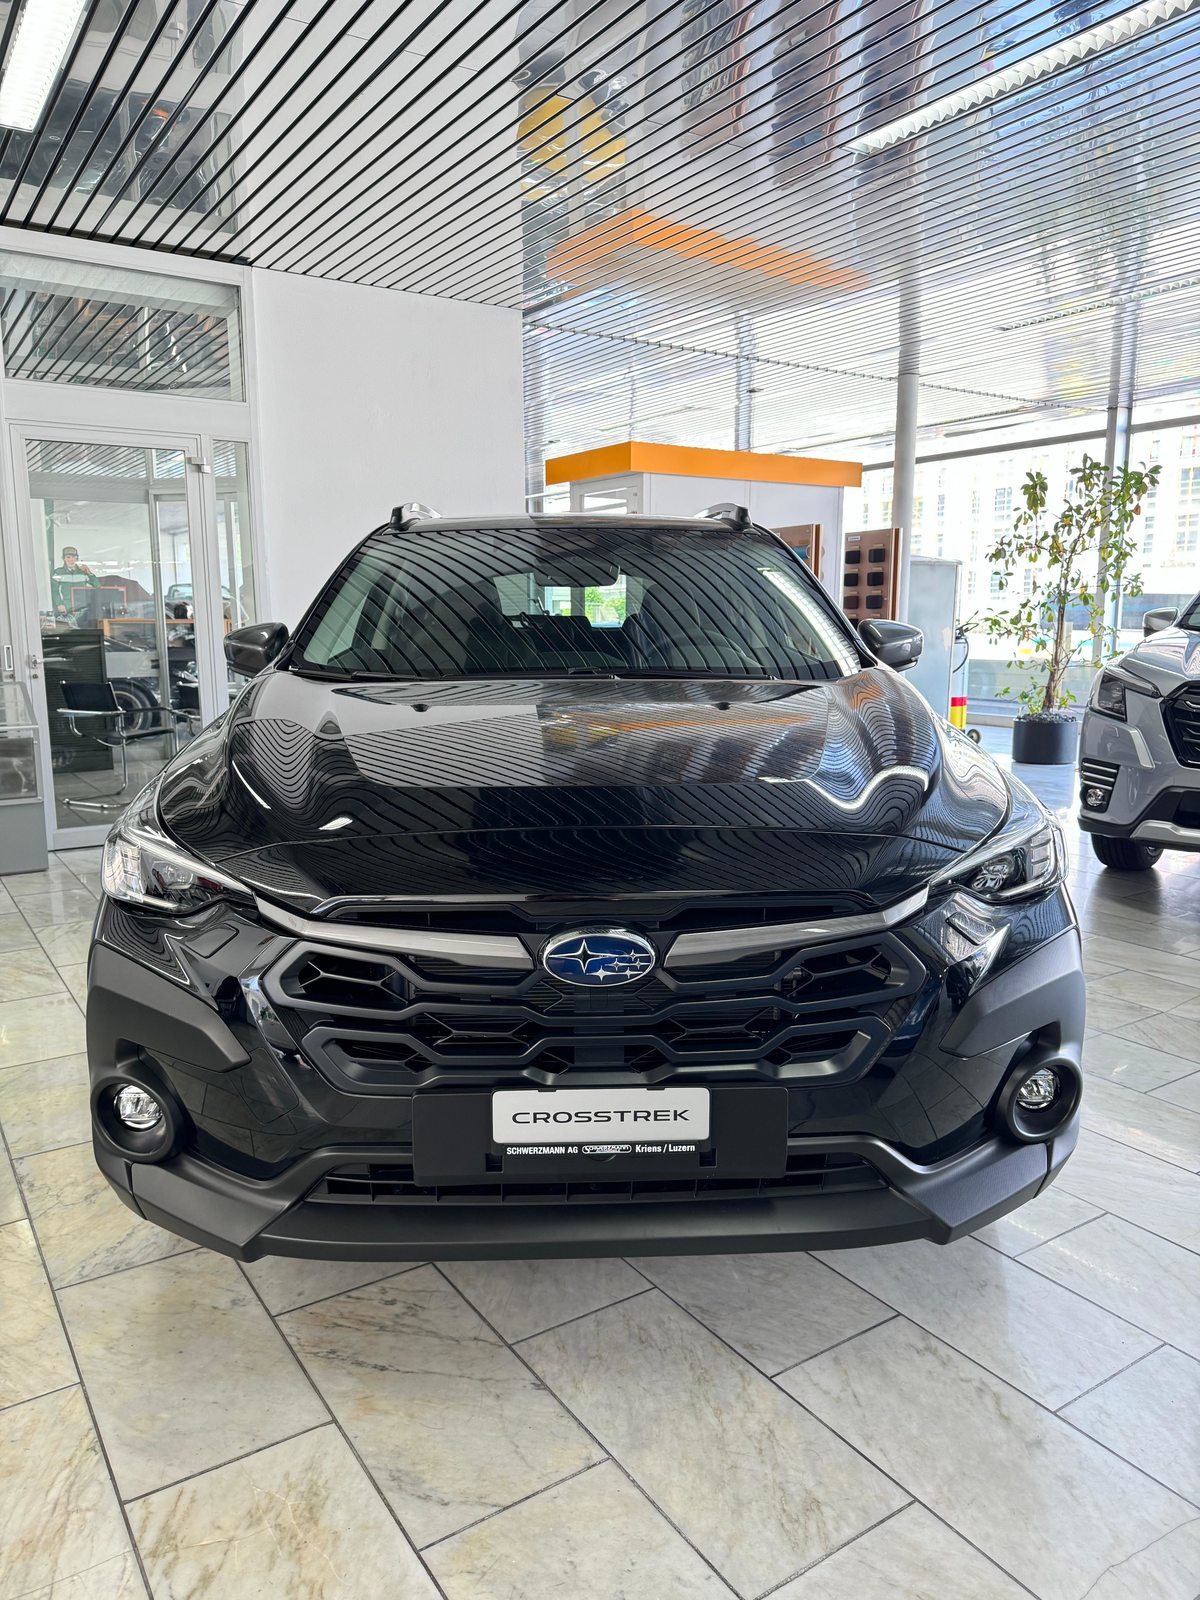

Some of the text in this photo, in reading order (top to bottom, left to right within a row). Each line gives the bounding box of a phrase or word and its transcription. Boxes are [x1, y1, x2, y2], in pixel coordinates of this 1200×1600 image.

[512, 1109, 690, 1124] CROSSTREK
[506, 1146, 566, 1155] SCHWERZMANN
[567, 1146, 579, 1154] AG
[635, 1144, 662, 1153] Kriens
[668, 1143, 696, 1152] Luzern
